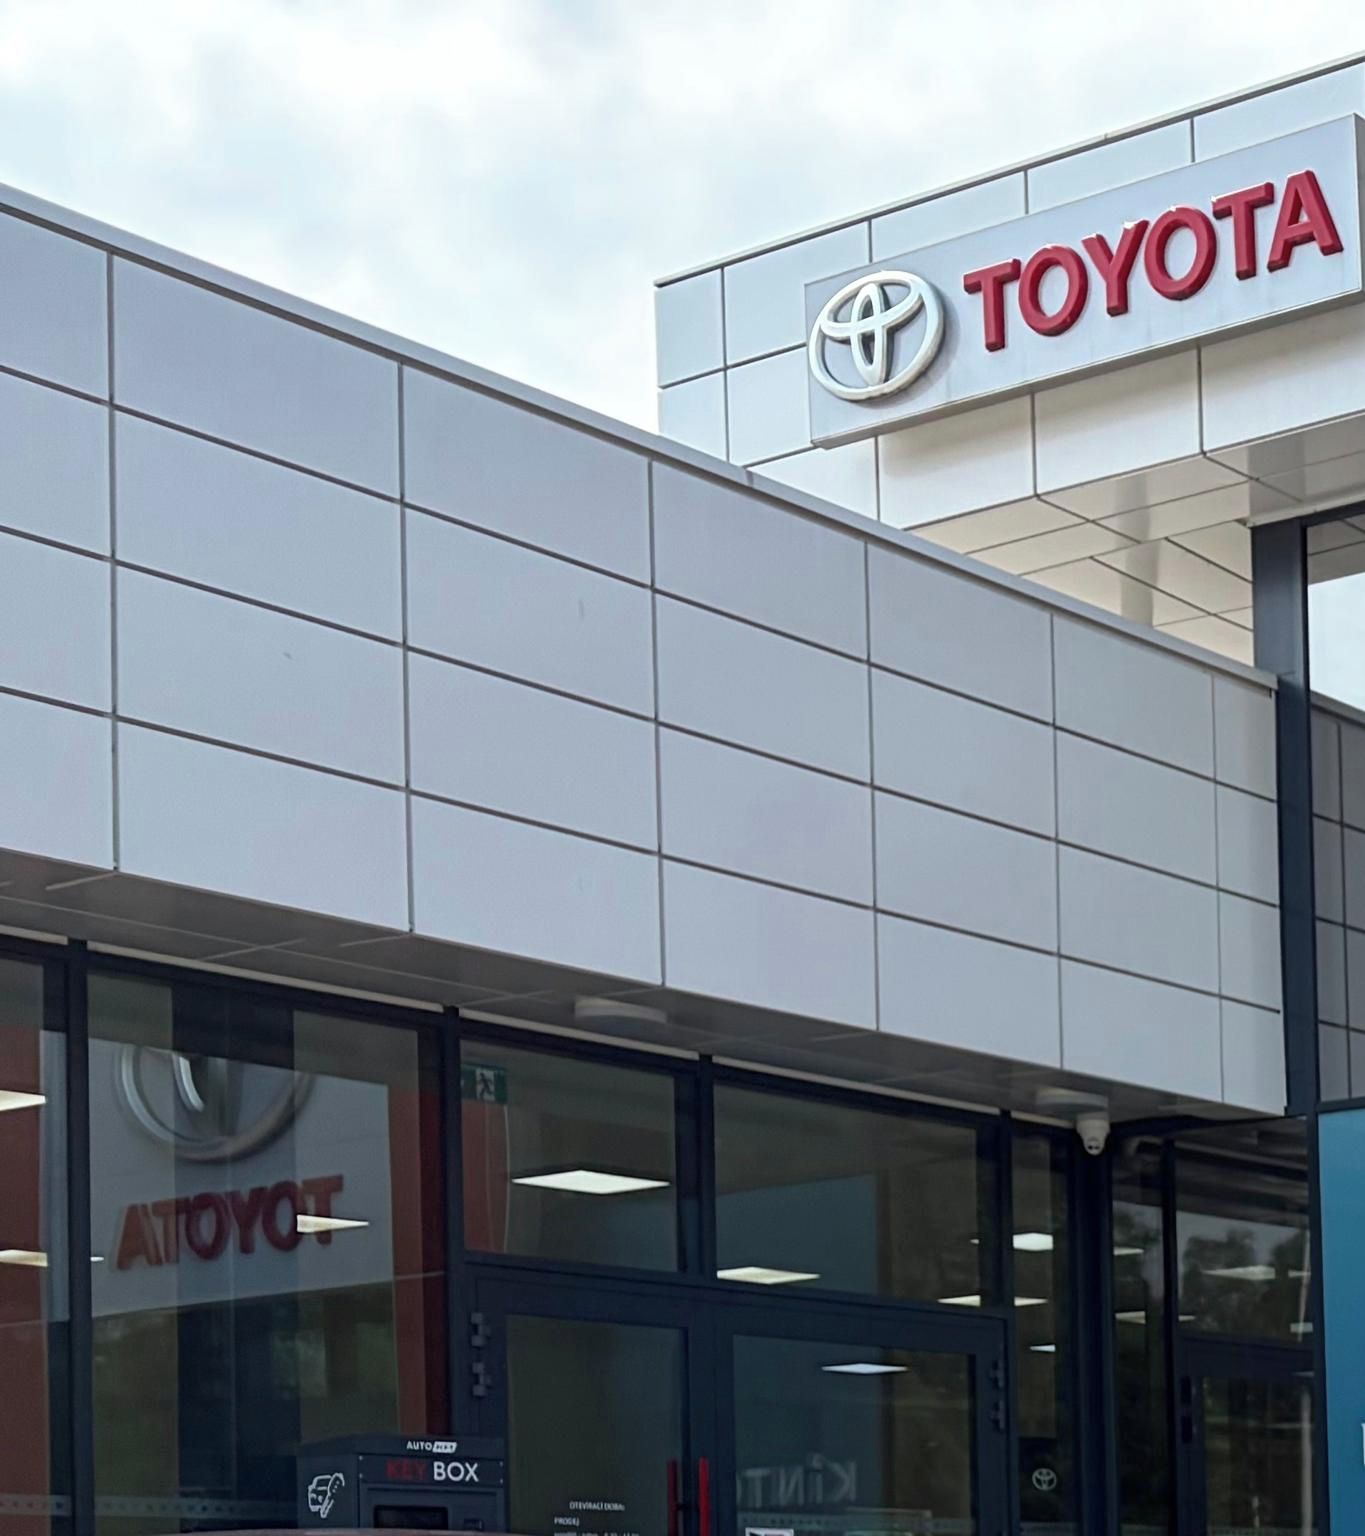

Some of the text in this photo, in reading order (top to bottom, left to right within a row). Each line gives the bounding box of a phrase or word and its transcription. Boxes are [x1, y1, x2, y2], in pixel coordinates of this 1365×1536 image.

[962, 169, 1344, 353] TOYOTA
[406, 1440, 432, 1451] AUTO
[386, 1461, 479, 1482] KEY BOX
